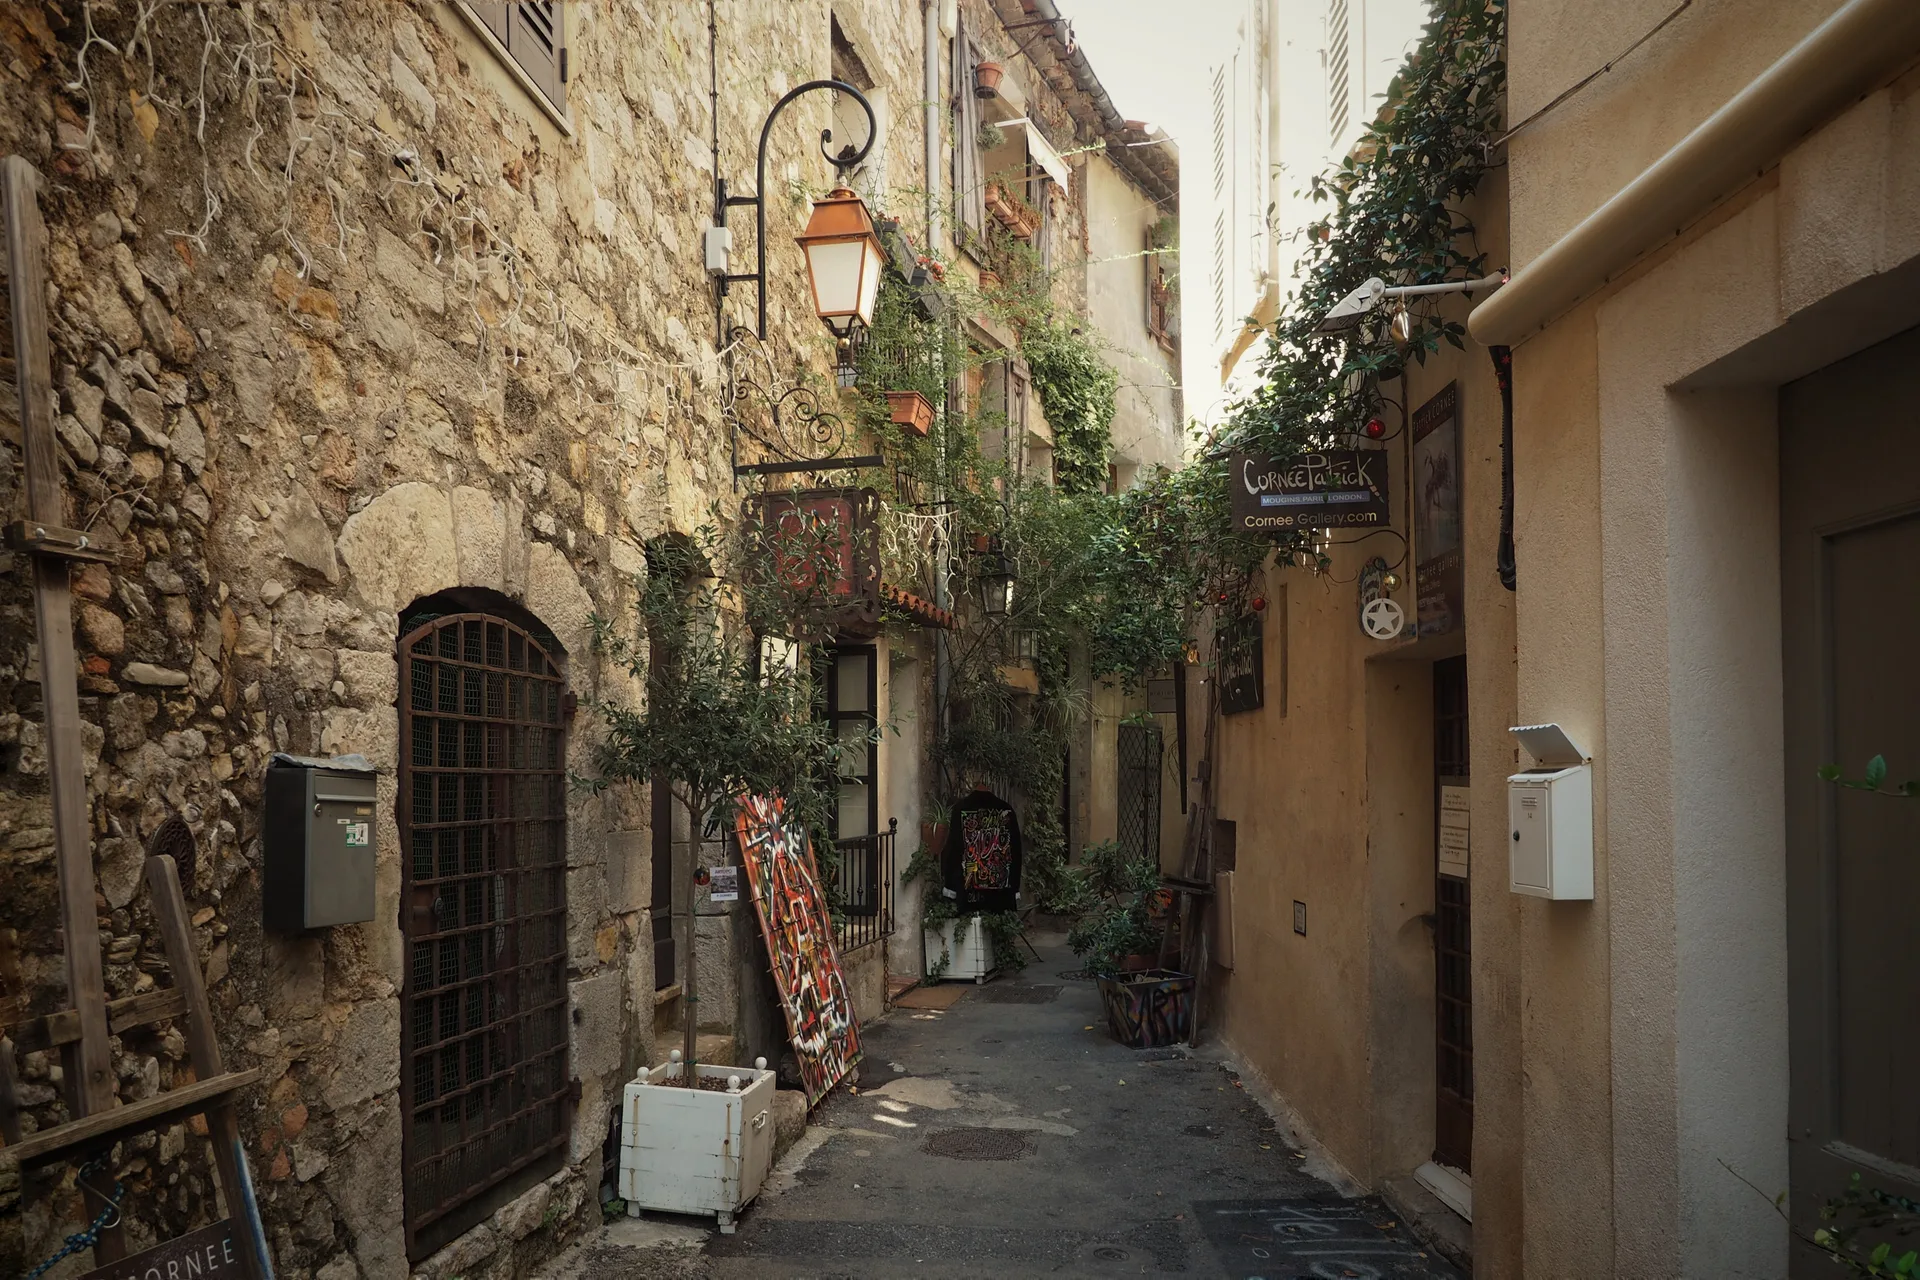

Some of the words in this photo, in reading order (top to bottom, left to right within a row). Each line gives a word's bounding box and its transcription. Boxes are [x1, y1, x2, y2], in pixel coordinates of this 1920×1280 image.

[1244, 515, 1294, 527] Cornee
[1297, 511, 1377, 526] Gallery.com
[124, 1238, 235, 1280] ORNEE
